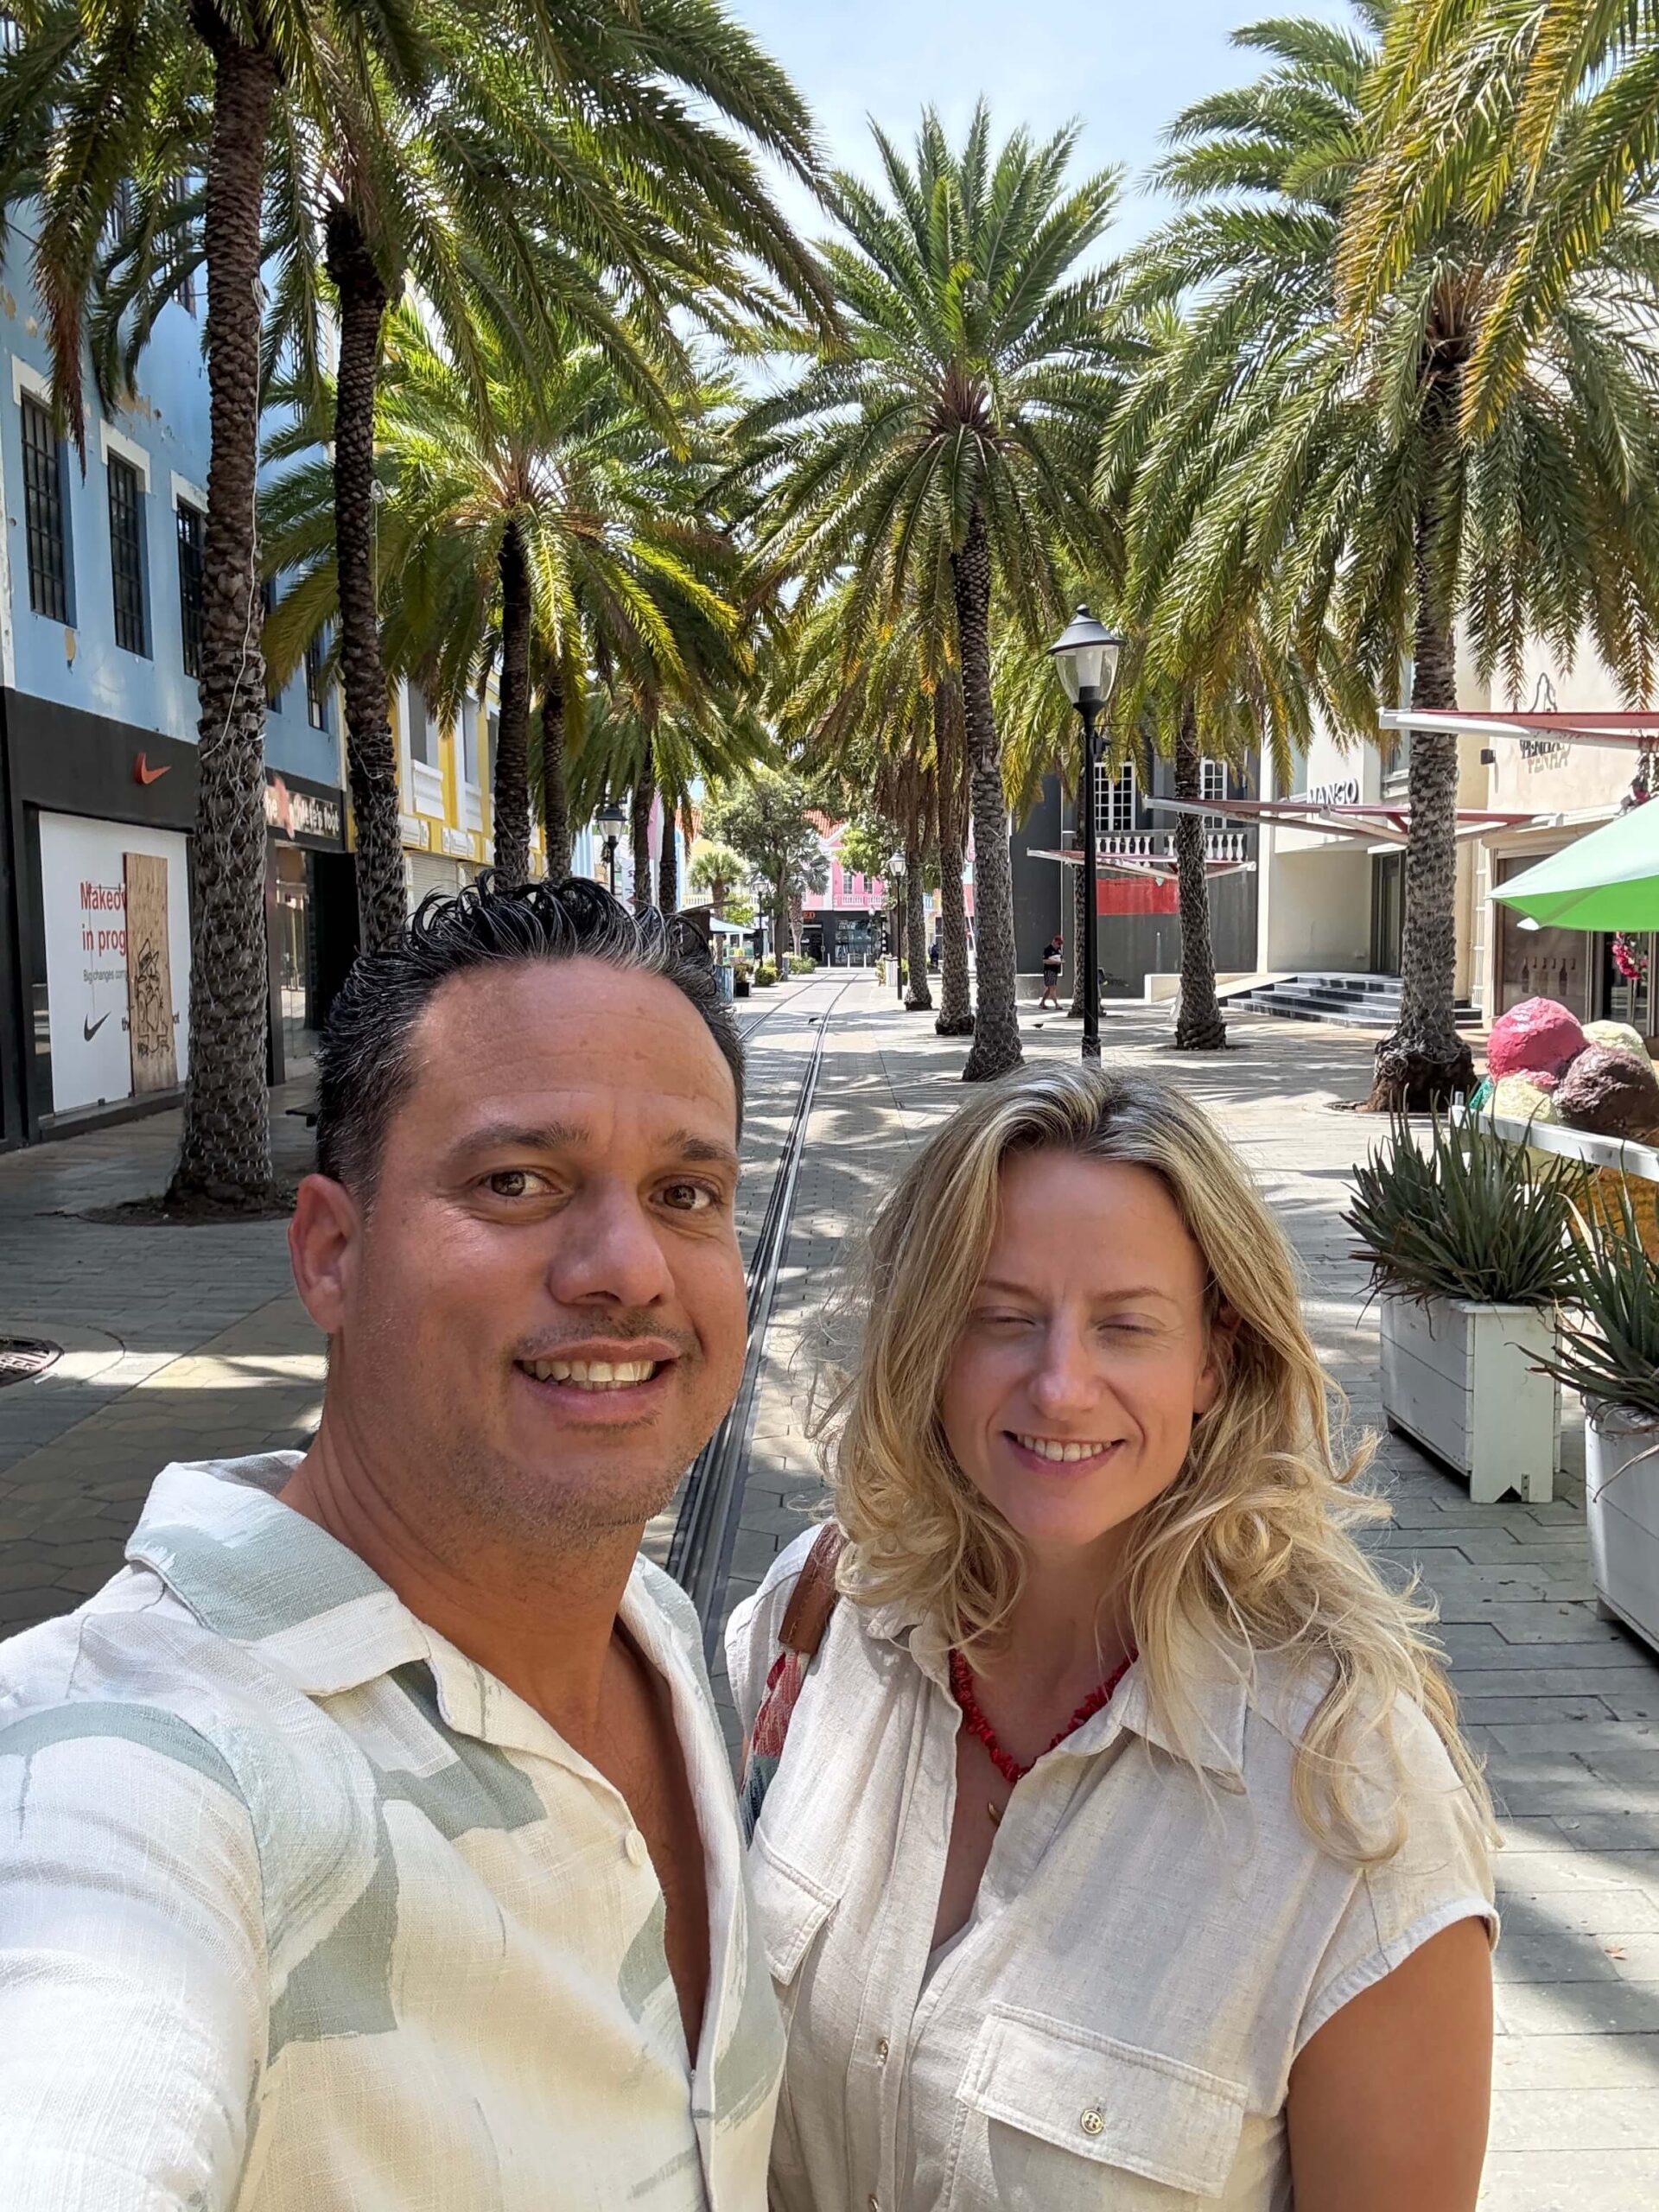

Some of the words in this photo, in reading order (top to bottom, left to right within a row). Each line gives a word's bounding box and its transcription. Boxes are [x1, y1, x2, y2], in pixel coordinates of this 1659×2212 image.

[1306, 779, 1359, 804] MANGO
[82, 923, 94, 951] in
[98, 929, 127, 957] prog
